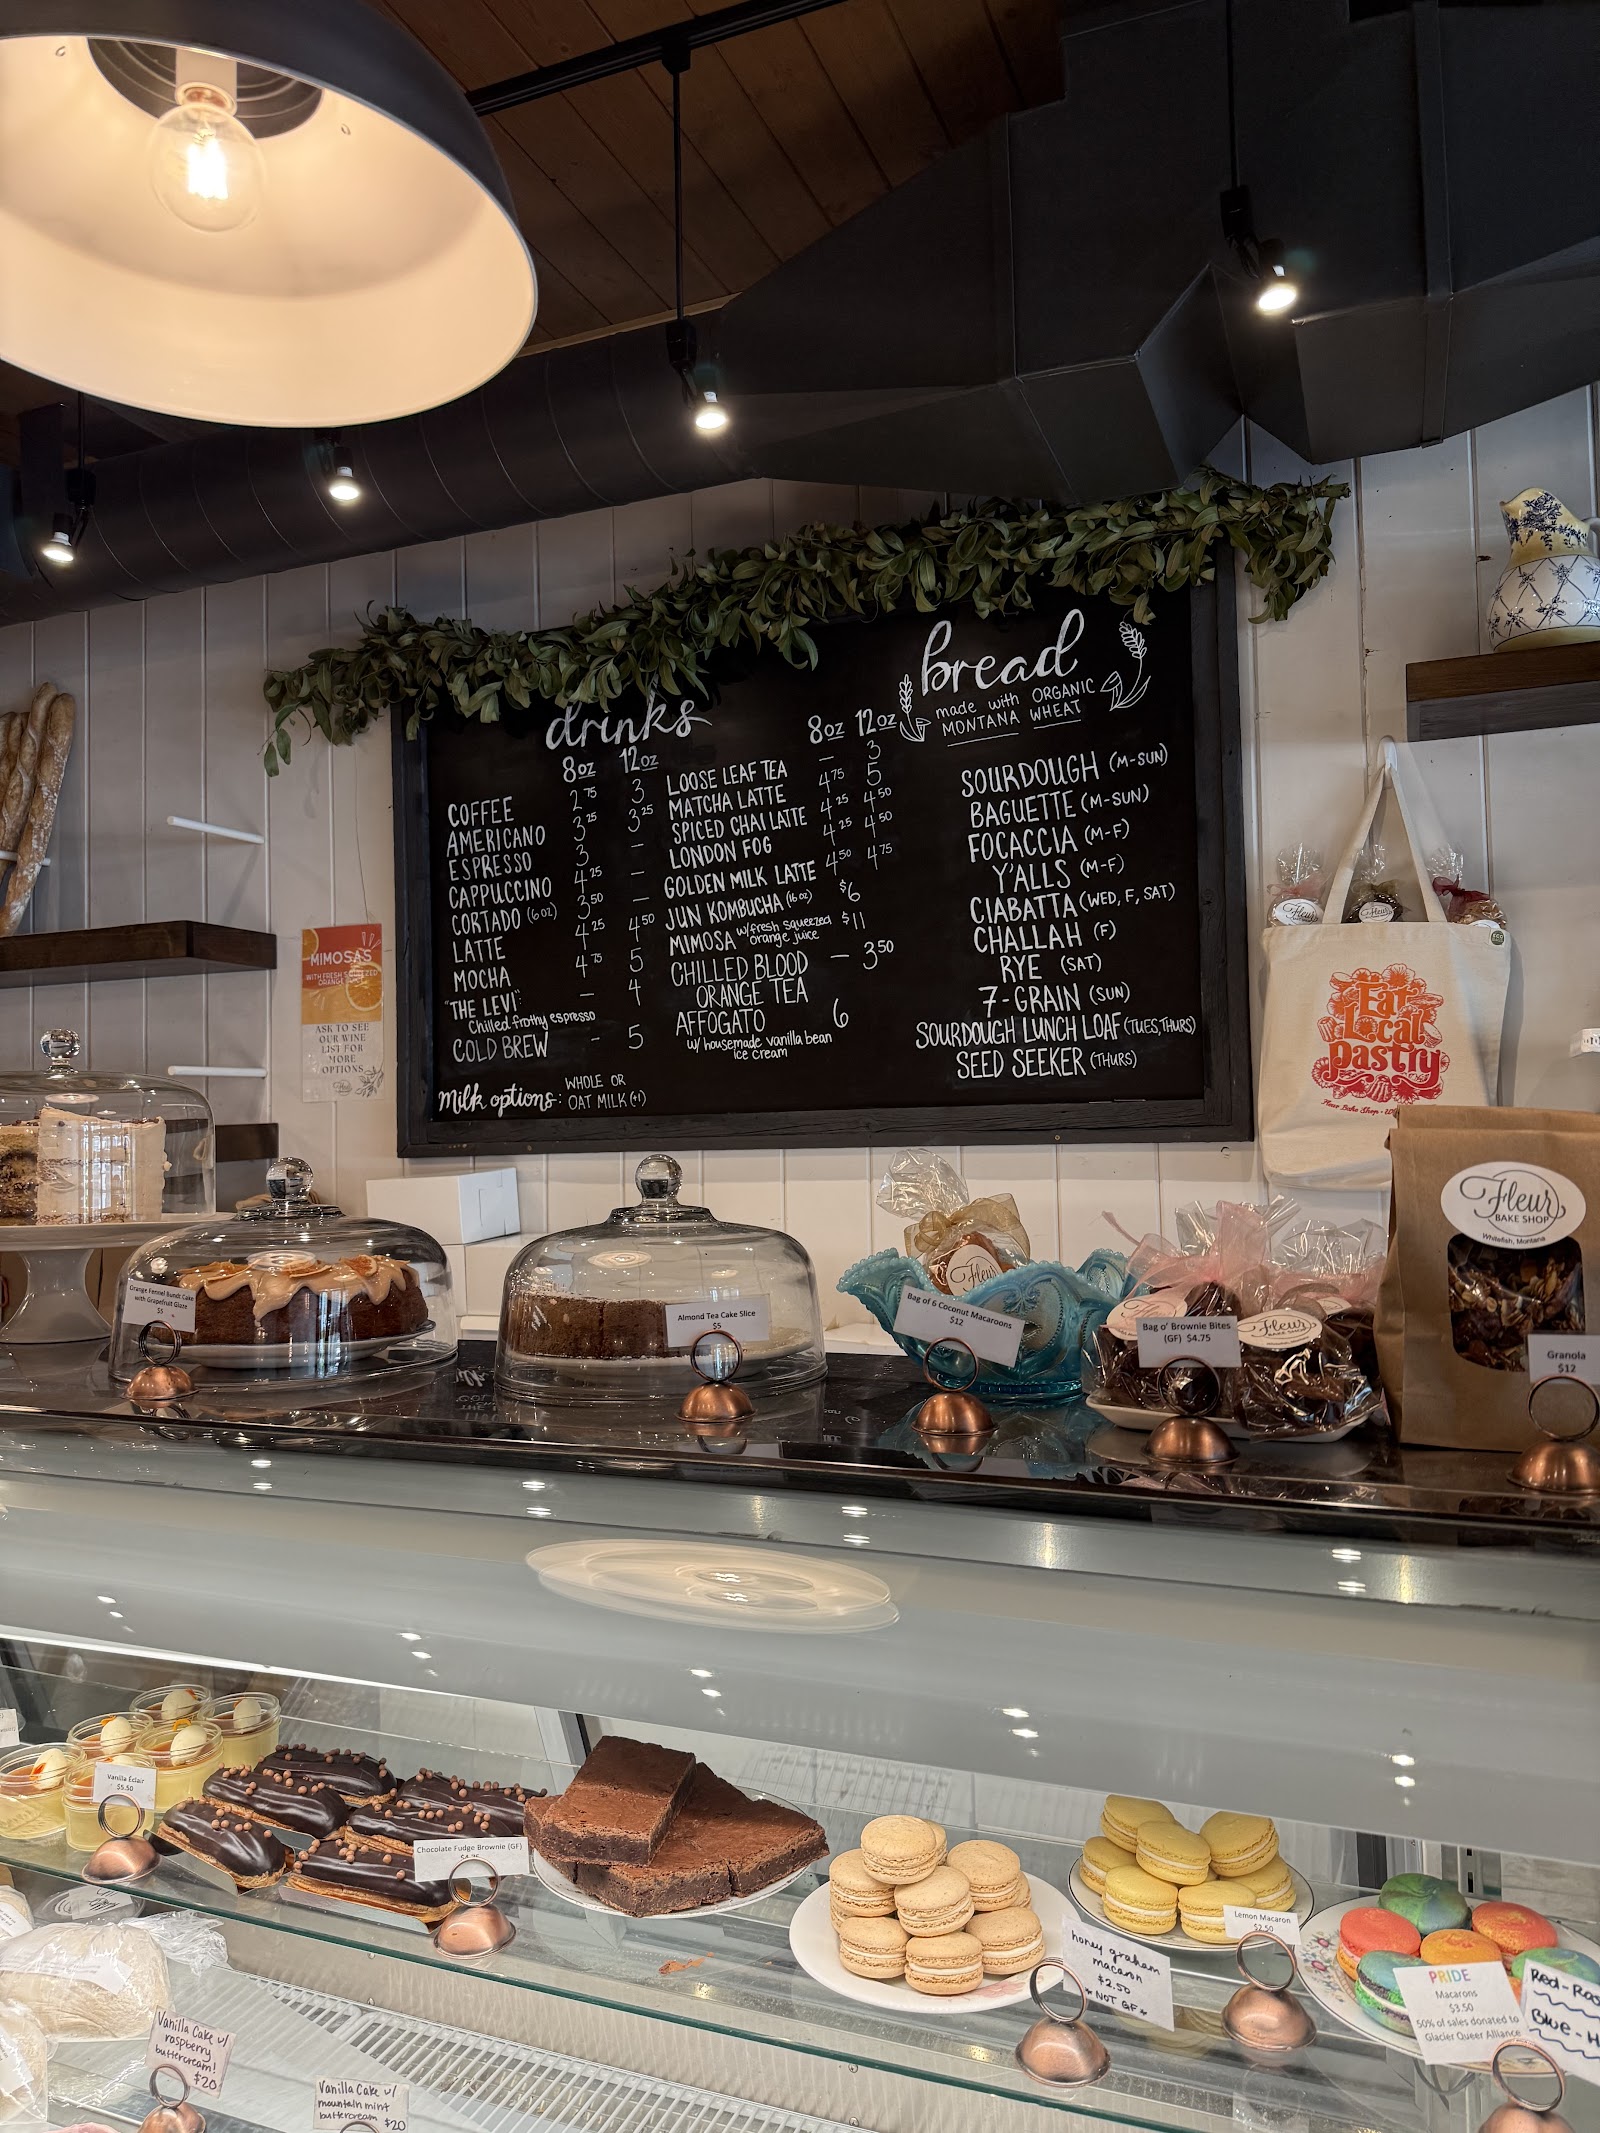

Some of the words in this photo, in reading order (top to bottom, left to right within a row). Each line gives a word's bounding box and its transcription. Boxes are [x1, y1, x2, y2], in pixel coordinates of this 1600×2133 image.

[921, 608, 1084, 696] bread
[936, 702, 977, 720] made
[988, 693, 1020, 710] with
[1032, 678, 1095, 704] ORGANIC
[546, 684, 712, 749] drinks
[941, 710, 1020, 738] MONTANA
[1031, 700, 1081, 721] WHEAT
[666, 769, 718, 796] LOOSE
[722, 761, 757, 785] LEAF
[760, 759, 788, 781] TEA
[961, 750, 1100, 798] SOURDOUGH
[1109, 742, 1168, 772] (M-SUN)
[448, 796, 514, 827] COFFEE
[668, 792, 733, 820] MATCHA
[737, 783, 786, 810] LATTE
[970, 789, 1077, 828] BAGUETTE
[1080, 783, 1149, 813] (M-SUN)
[672, 819, 724, 844] SPICED
[730, 812, 766, 837] CHAI
[769, 806, 808, 831] LATTE
[447, 825, 545, 857] AMERICANO
[669, 840, 736, 870] LONDON
[742, 836, 772, 858] FOG
[968, 825, 1078, 863] FOCACCIA
[449, 852, 531, 881] ESPRESSO
[664, 871, 725, 899] GOLDEN
[730, 866, 768, 890] MILK
[774, 860, 817, 884] LATTE
[992, 859, 1071, 893] Y'ALLS
[449, 877, 551, 909] CAPPUCCINO
[665, 905, 702, 931] JUN
[706, 893, 784, 924] KOMBUCHA
[840, 880, 860, 902] $6
[970, 892, 1078, 924] CIABATTA
[452, 907, 520, 936] CORTADO
[670, 931, 736, 957] MIMOSA
[783, 915, 832, 932] squeezed
[841, 911, 865, 931] $11
[453, 936, 505, 963] LATTE
[750, 931, 791, 948] orange
[793, 929, 819, 945] juice
[973, 921, 1082, 955] CHALLAH
[1094, 920, 1117, 941] (F)
[310, 949, 372, 967] MIMOSAS
[671, 956, 749, 986] CHILLED
[754, 950, 808, 980] BLOOD
[1000, 953, 1042, 983] RYE
[1060, 952, 1102, 976] (SAT)
[454, 966, 511, 992] MOCHA
[696, 981, 764, 1008] ORANGE
[769, 976, 808, 1004] TEA
[1089, 981, 1131, 1005] (SUN)
[1356, 982, 1420, 1019] Eat
[315, 1024, 333, 1034] ASK
[336, 1024, 349, 1033] TO
[351, 1022, 369, 1032] SEE
[469, 1016, 511, 1034] Chilled
[512, 1014, 548, 1031] frothy
[550, 1011, 596, 1024] espresso
[676, 1008, 765, 1036] AFFOGATO
[916, 1016, 1016, 1050] SOURDOUGH
[1023, 1015, 1077, 1044] LUNCH
[1082, 1012, 1121, 1040] LOAF
[318, 1034, 339, 1044] OUR
[341, 1033, 367, 1043] WINE
[321, 1044, 341, 1054] LIST
[344, 1043, 364, 1053] FOR
[453, 1038, 497, 1062] COLD
[502, 1031, 548, 1059] BREW
[703, 1035, 763, 1051] housemade
[766, 1030, 803, 1047] vanilla
[804, 1032, 833, 1045] bean
[328, 1054, 356, 1064] MORE
[733, 1049, 748, 1060] ice
[752, 1047, 788, 1059] cream
[956, 1050, 1004, 1079] SEED
[1012, 1046, 1086, 1078] SEEKER
[1090, 1049, 1137, 1070] (THURS)
[322, 1064, 364, 1075] OPTIONS
[565, 1074, 604, 1090] WHOLE
[610, 1074, 626, 1086] OR
[568, 1094, 591, 1110] OAT
[598, 1092, 627, 1109] MILK
[1460, 1175, 1566, 1219] Fleur
[1495, 1213, 1519, 1223] BAKE
[1522, 1214, 1550, 1225] SHOP
[129, 1285, 148, 1295] Orange
[181, 1293, 195, 1303] Cake
[134, 1295, 146, 1303] with
[677, 1312, 705, 1322] Almond
[706, 1312, 719, 1321] Tea
[720, 1311, 738, 1320] Cake
[739, 1309, 756, 1318] Slice
[907, 1292, 921, 1304] Bag
[931, 1299, 938, 1308] 6
[938, 1301, 969, 1318] Coconut
[970, 1310, 1012, 1330] Macaroons
[950, 1315, 964, 1327] $12
[712, 1321, 722, 1331] $5
[1142, 1322, 1159, 1334] Bag
[1170, 1321, 1207, 1331] Brownie
[1208, 1320, 1231, 1331] Bites
[1164, 1333, 1182, 1344] (GF)
[1186, 1333, 1211, 1344] $4.75
[1547, 1350, 1586, 1361] Granola
[1557, 1363, 1577, 1375] $12
[107, 1773, 127, 1783] Vanilla
[117, 1783, 134, 1792] $5.50
[416, 1845, 452, 1854] Chocolate
[454, 1844, 476, 1853] Fudge
[477, 1843, 506, 1851] Brownie
[1234, 1911, 1257, 1921] Lemon
[1260, 1914, 1291, 1924] Macaron
[1072, 1930, 1102, 1955] honey
[1109, 1948, 1160, 1975] graham
[1092, 1957, 1143, 1984] macaron
[1429, 1969, 1472, 1984] PRIDE
[1098, 1974, 1131, 1994] $2.50
[1435, 1989, 1479, 2000] Macarons
[1096, 1990, 1117, 2005] NOT
[1449, 2003, 1474, 2014] $3.50
[158, 2010, 190, 2033] Vanilla
[192, 2025, 214, 2045] Cake
[1416, 2018, 1435, 2029] 50%
[1447, 2016, 1469, 2027] sales
[1470, 2015, 1507, 2026] donated
[1425, 2031, 1455, 2042] Glacier
[1456, 2030, 1484, 2041] Queer
[1486, 2028, 1521, 2040] Alliance
[156, 2044, 217, 2074] buttercream!
[165, 2034, 212, 2063] raspberry
[194, 2071, 218, 2091] $20
[319, 2080, 354, 2095] Vanilla
[357, 2083, 380, 2097] Cake
[318, 2099, 363, 2110] mountain
[365, 2102, 390, 2112] mint
[319, 2111, 378, 2121] buttercream
[385, 2118, 406, 2131] $20
